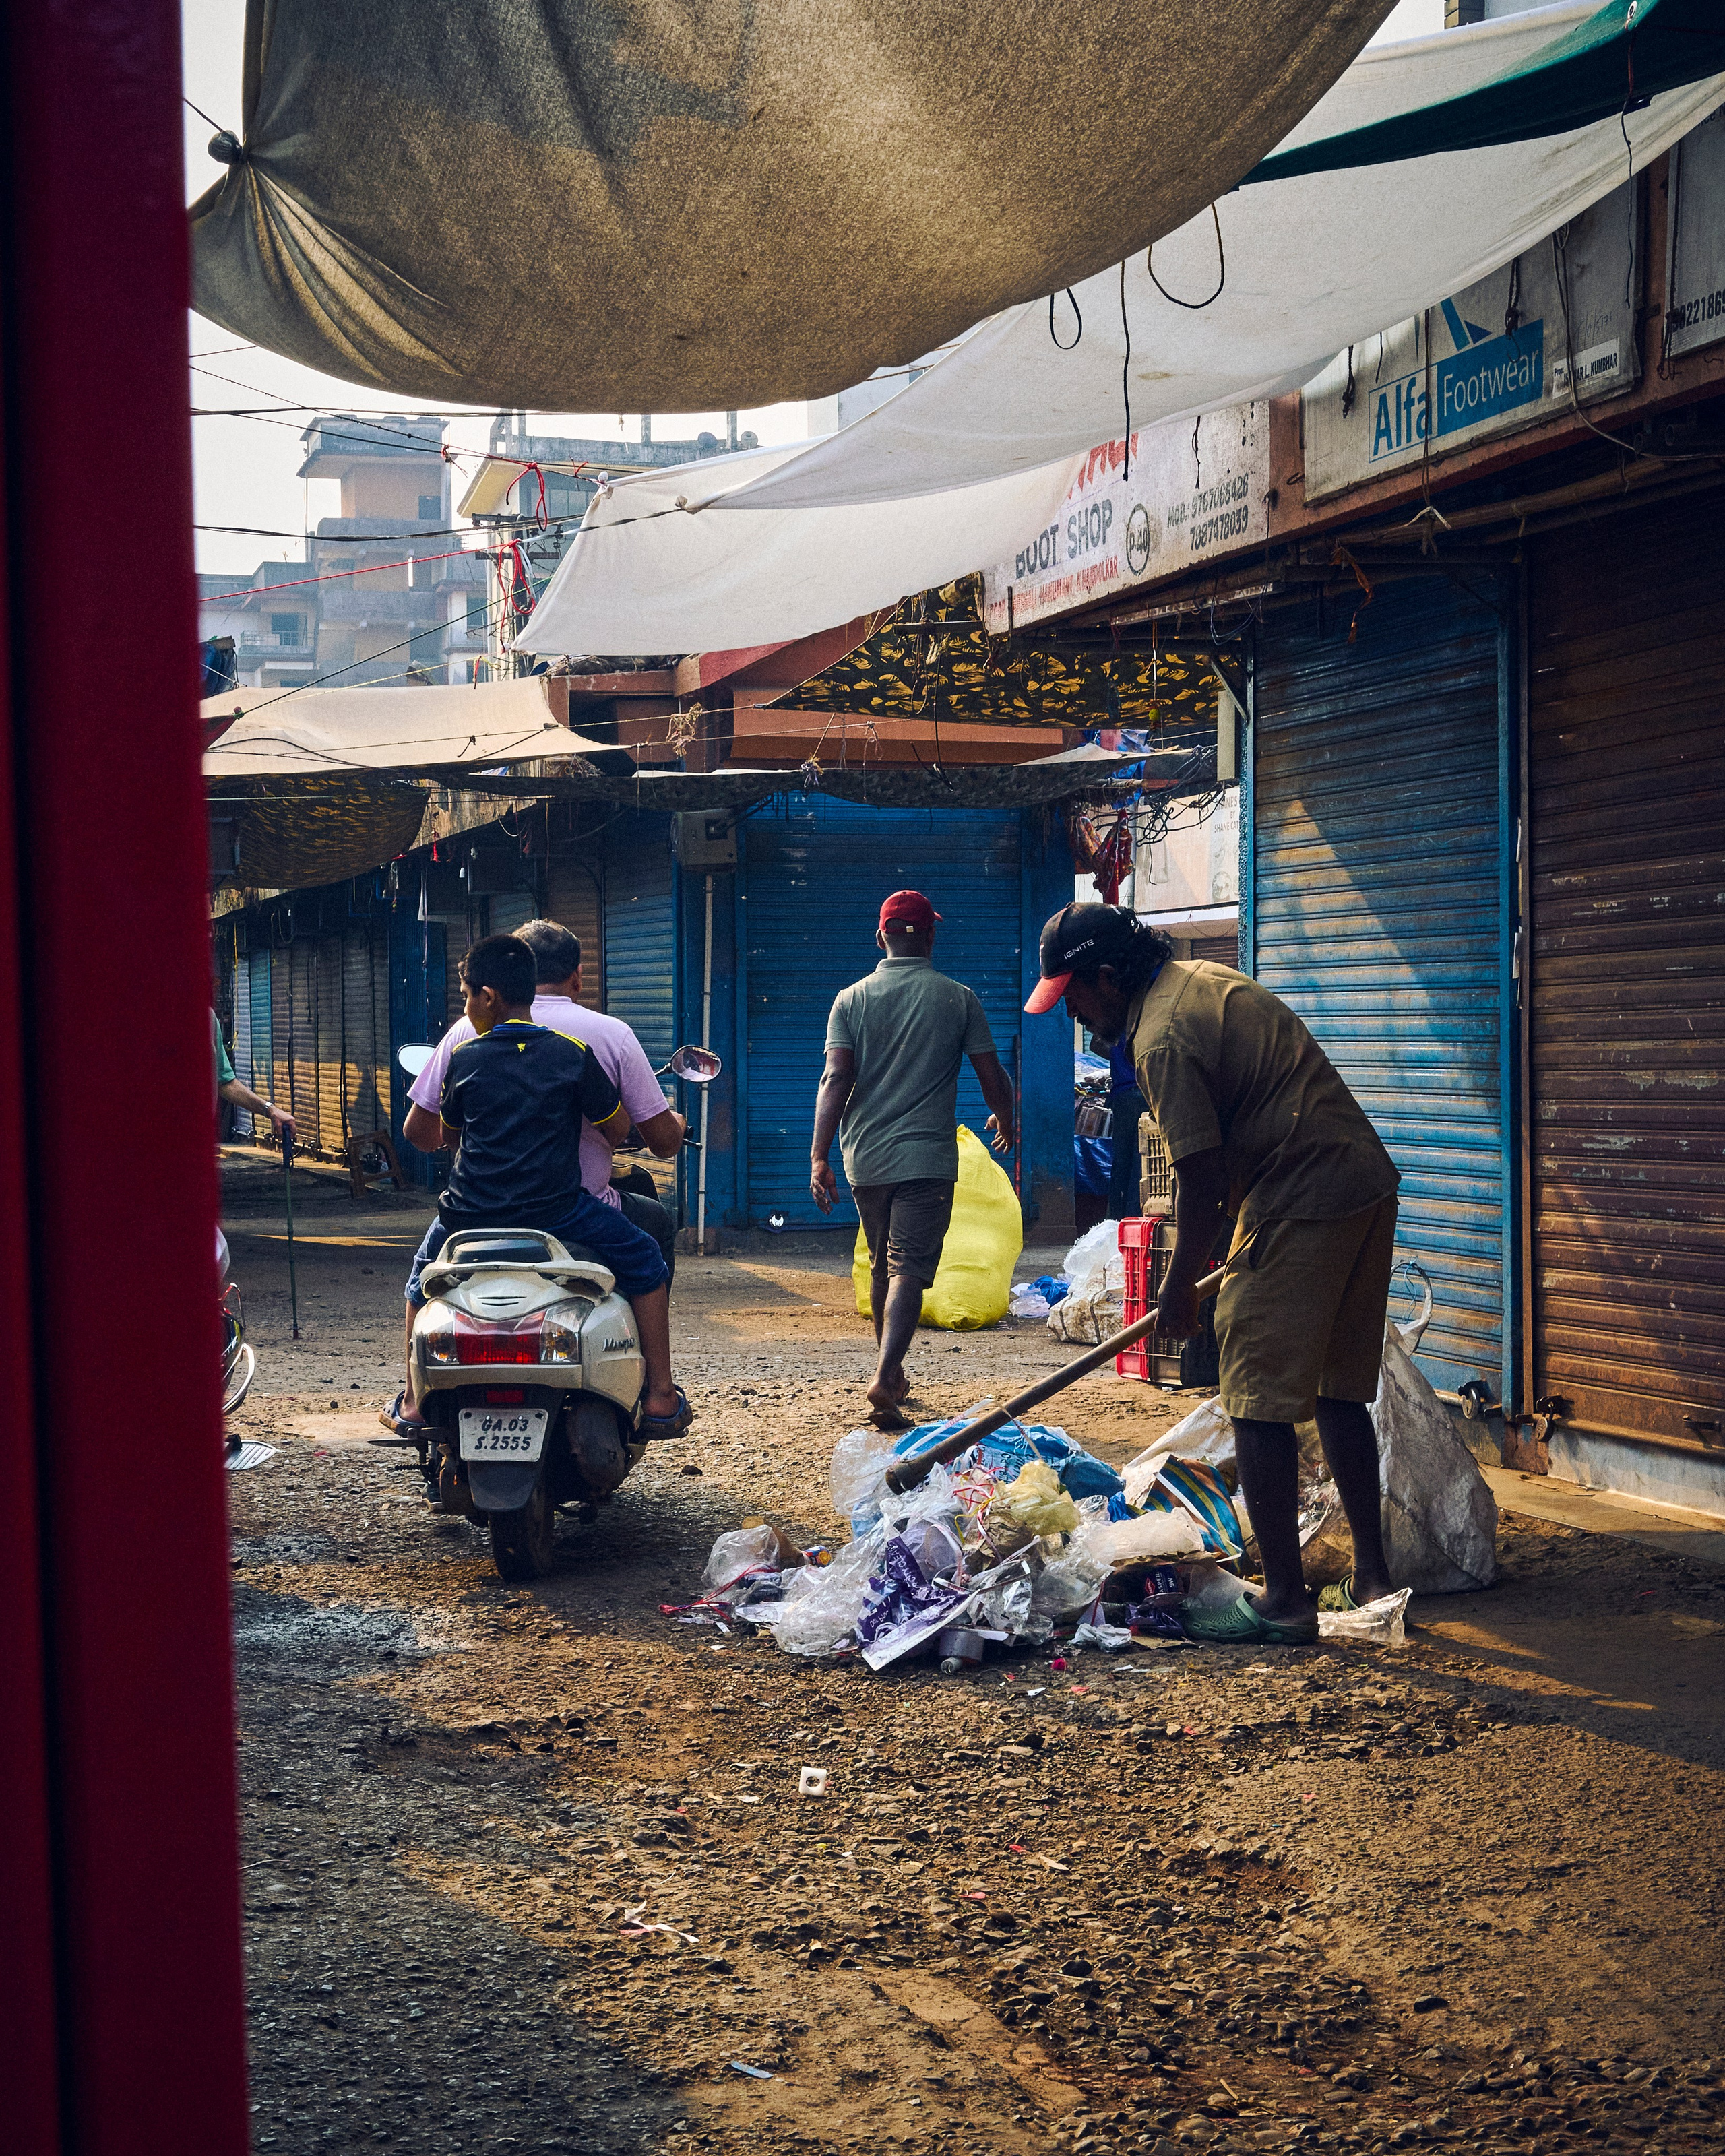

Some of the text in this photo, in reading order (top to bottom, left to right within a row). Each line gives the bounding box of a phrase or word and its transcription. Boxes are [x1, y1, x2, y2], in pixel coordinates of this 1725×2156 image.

[1590, 352, 1618, 377] KUMBHAR
[1373, 350, 1539, 456] Alfa Footwear
[1067, 499, 1112, 559] SHOP
[1215, 822, 1230, 833] SHANE
[1063, 939, 1095, 960] IGNITE
[481, 1418, 529, 1432] GA.03
[474, 1436, 532, 1451] S.2555
